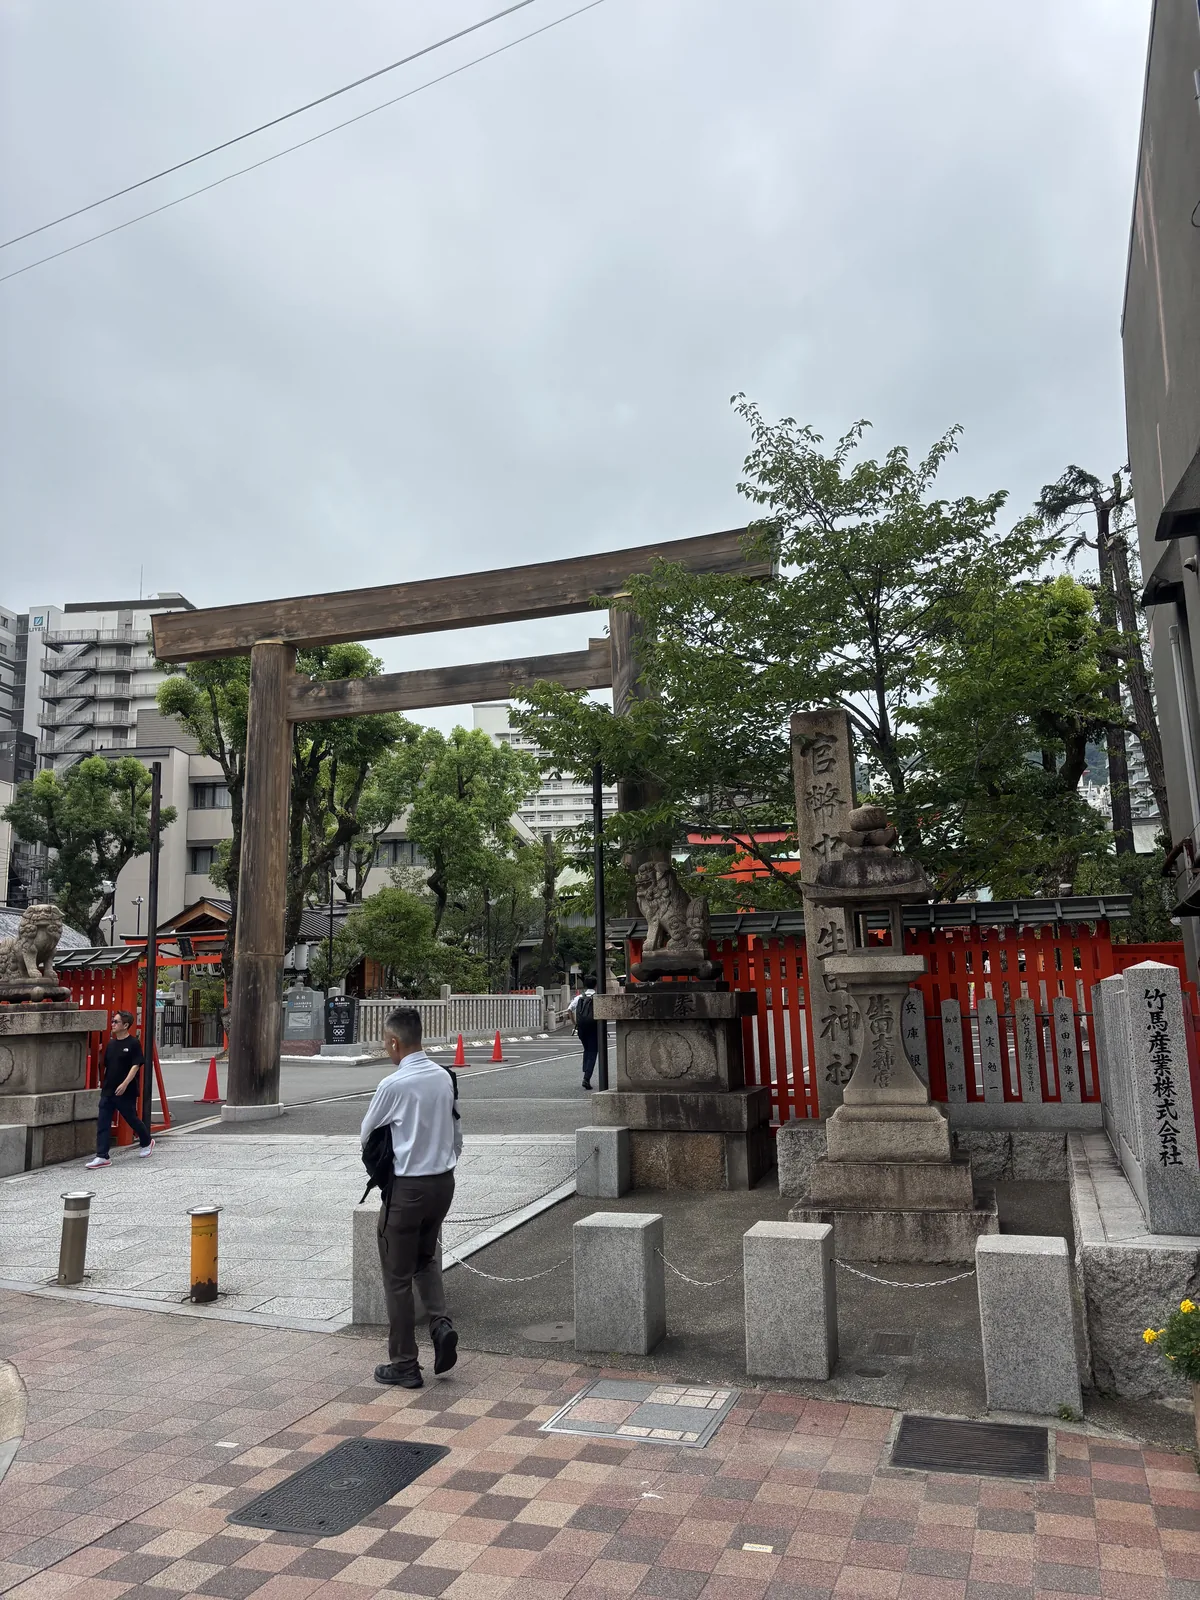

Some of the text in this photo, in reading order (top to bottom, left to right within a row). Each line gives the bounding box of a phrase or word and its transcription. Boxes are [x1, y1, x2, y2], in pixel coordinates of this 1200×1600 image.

[1144, 988, 1183, 1167] 竹馬産業株式会社
